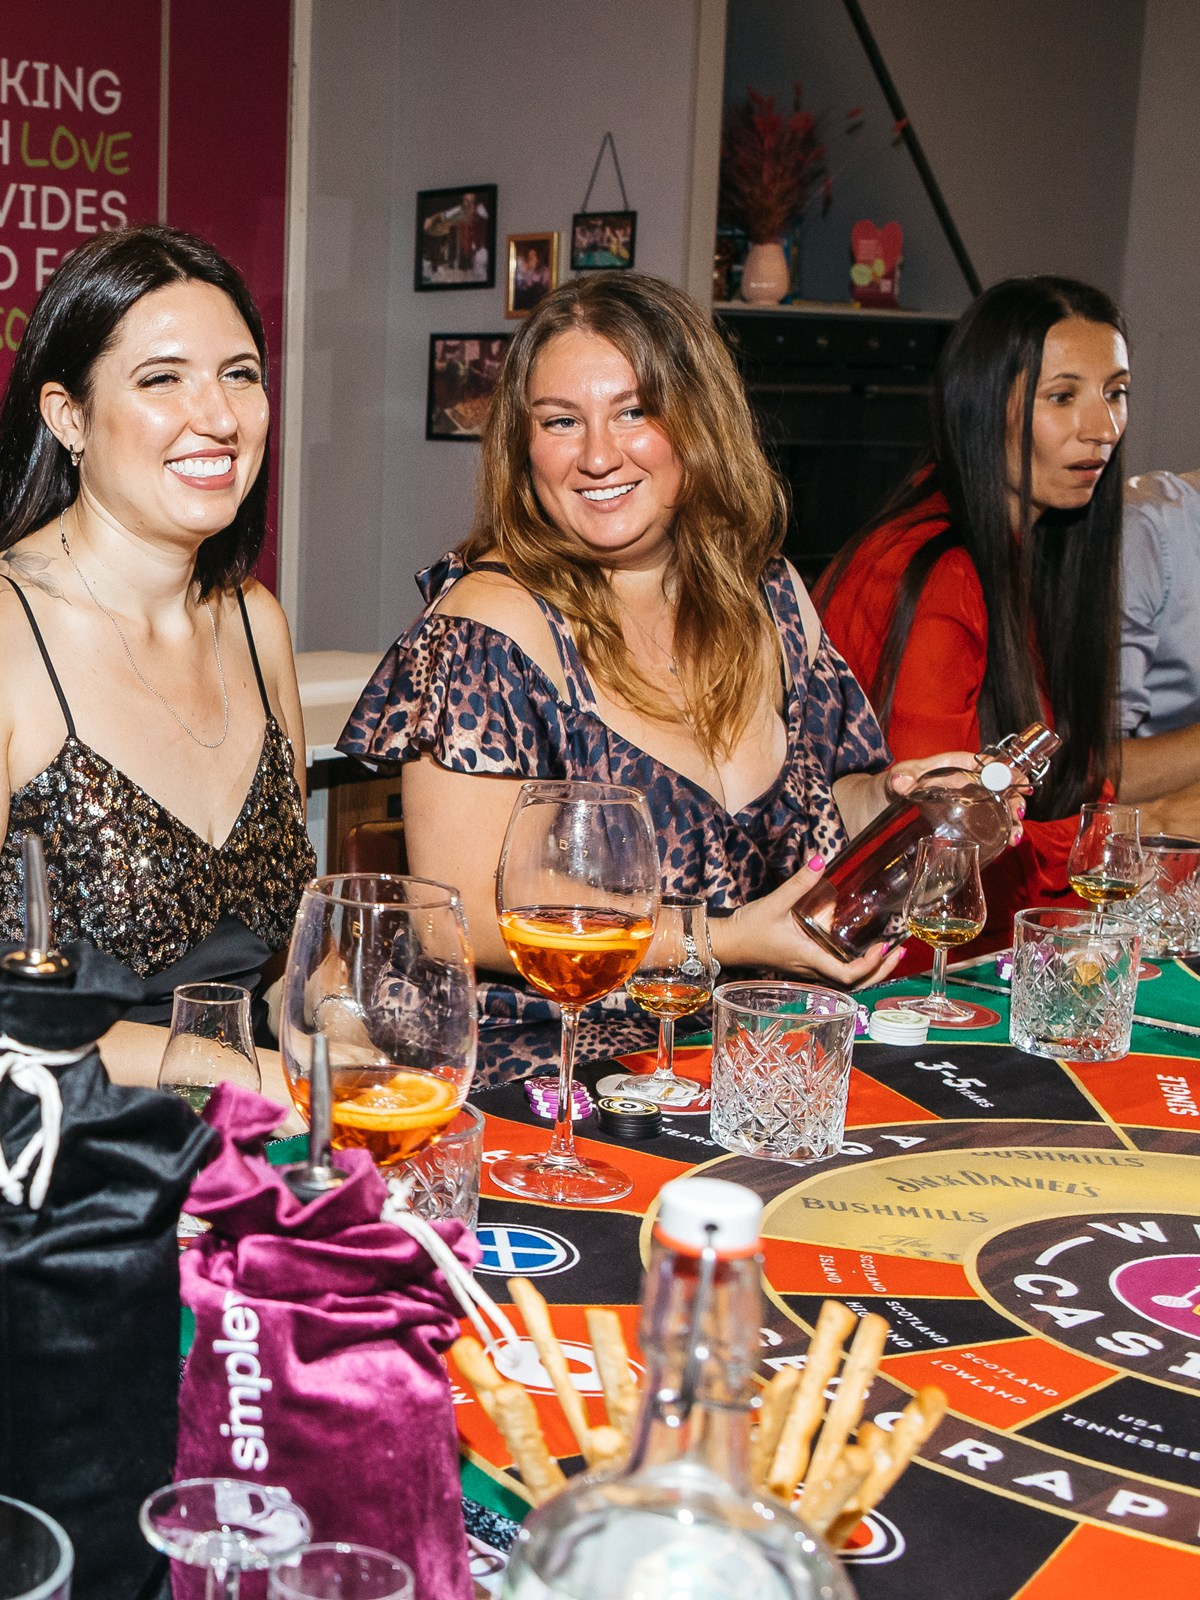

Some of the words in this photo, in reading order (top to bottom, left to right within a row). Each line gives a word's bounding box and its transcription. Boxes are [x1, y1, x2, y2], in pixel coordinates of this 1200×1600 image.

[19, 120, 132, 176] LOVE
[914, 1060, 988, 1090] 3-5
[955, 1086, 995, 1110] YEARS
[1156, 1073, 1200, 1117] SINGLE
[969, 1151, 1145, 1169] USHMILLS
[800, 1196, 990, 1225] BUSHMILLS
[818, 1254, 843, 1285] ISLAND
[859, 1254, 888, 1294] SCOTLAND
[885, 1300, 949, 1345] SCOTLAND
[930, 1359, 1028, 1406] LOWLAND
[960, 1352, 1060, 1398] SCOTLAND
[1061, 1412, 1200, 1462] TENNESSEE
[1117, 1413, 1165, 1433] USA
